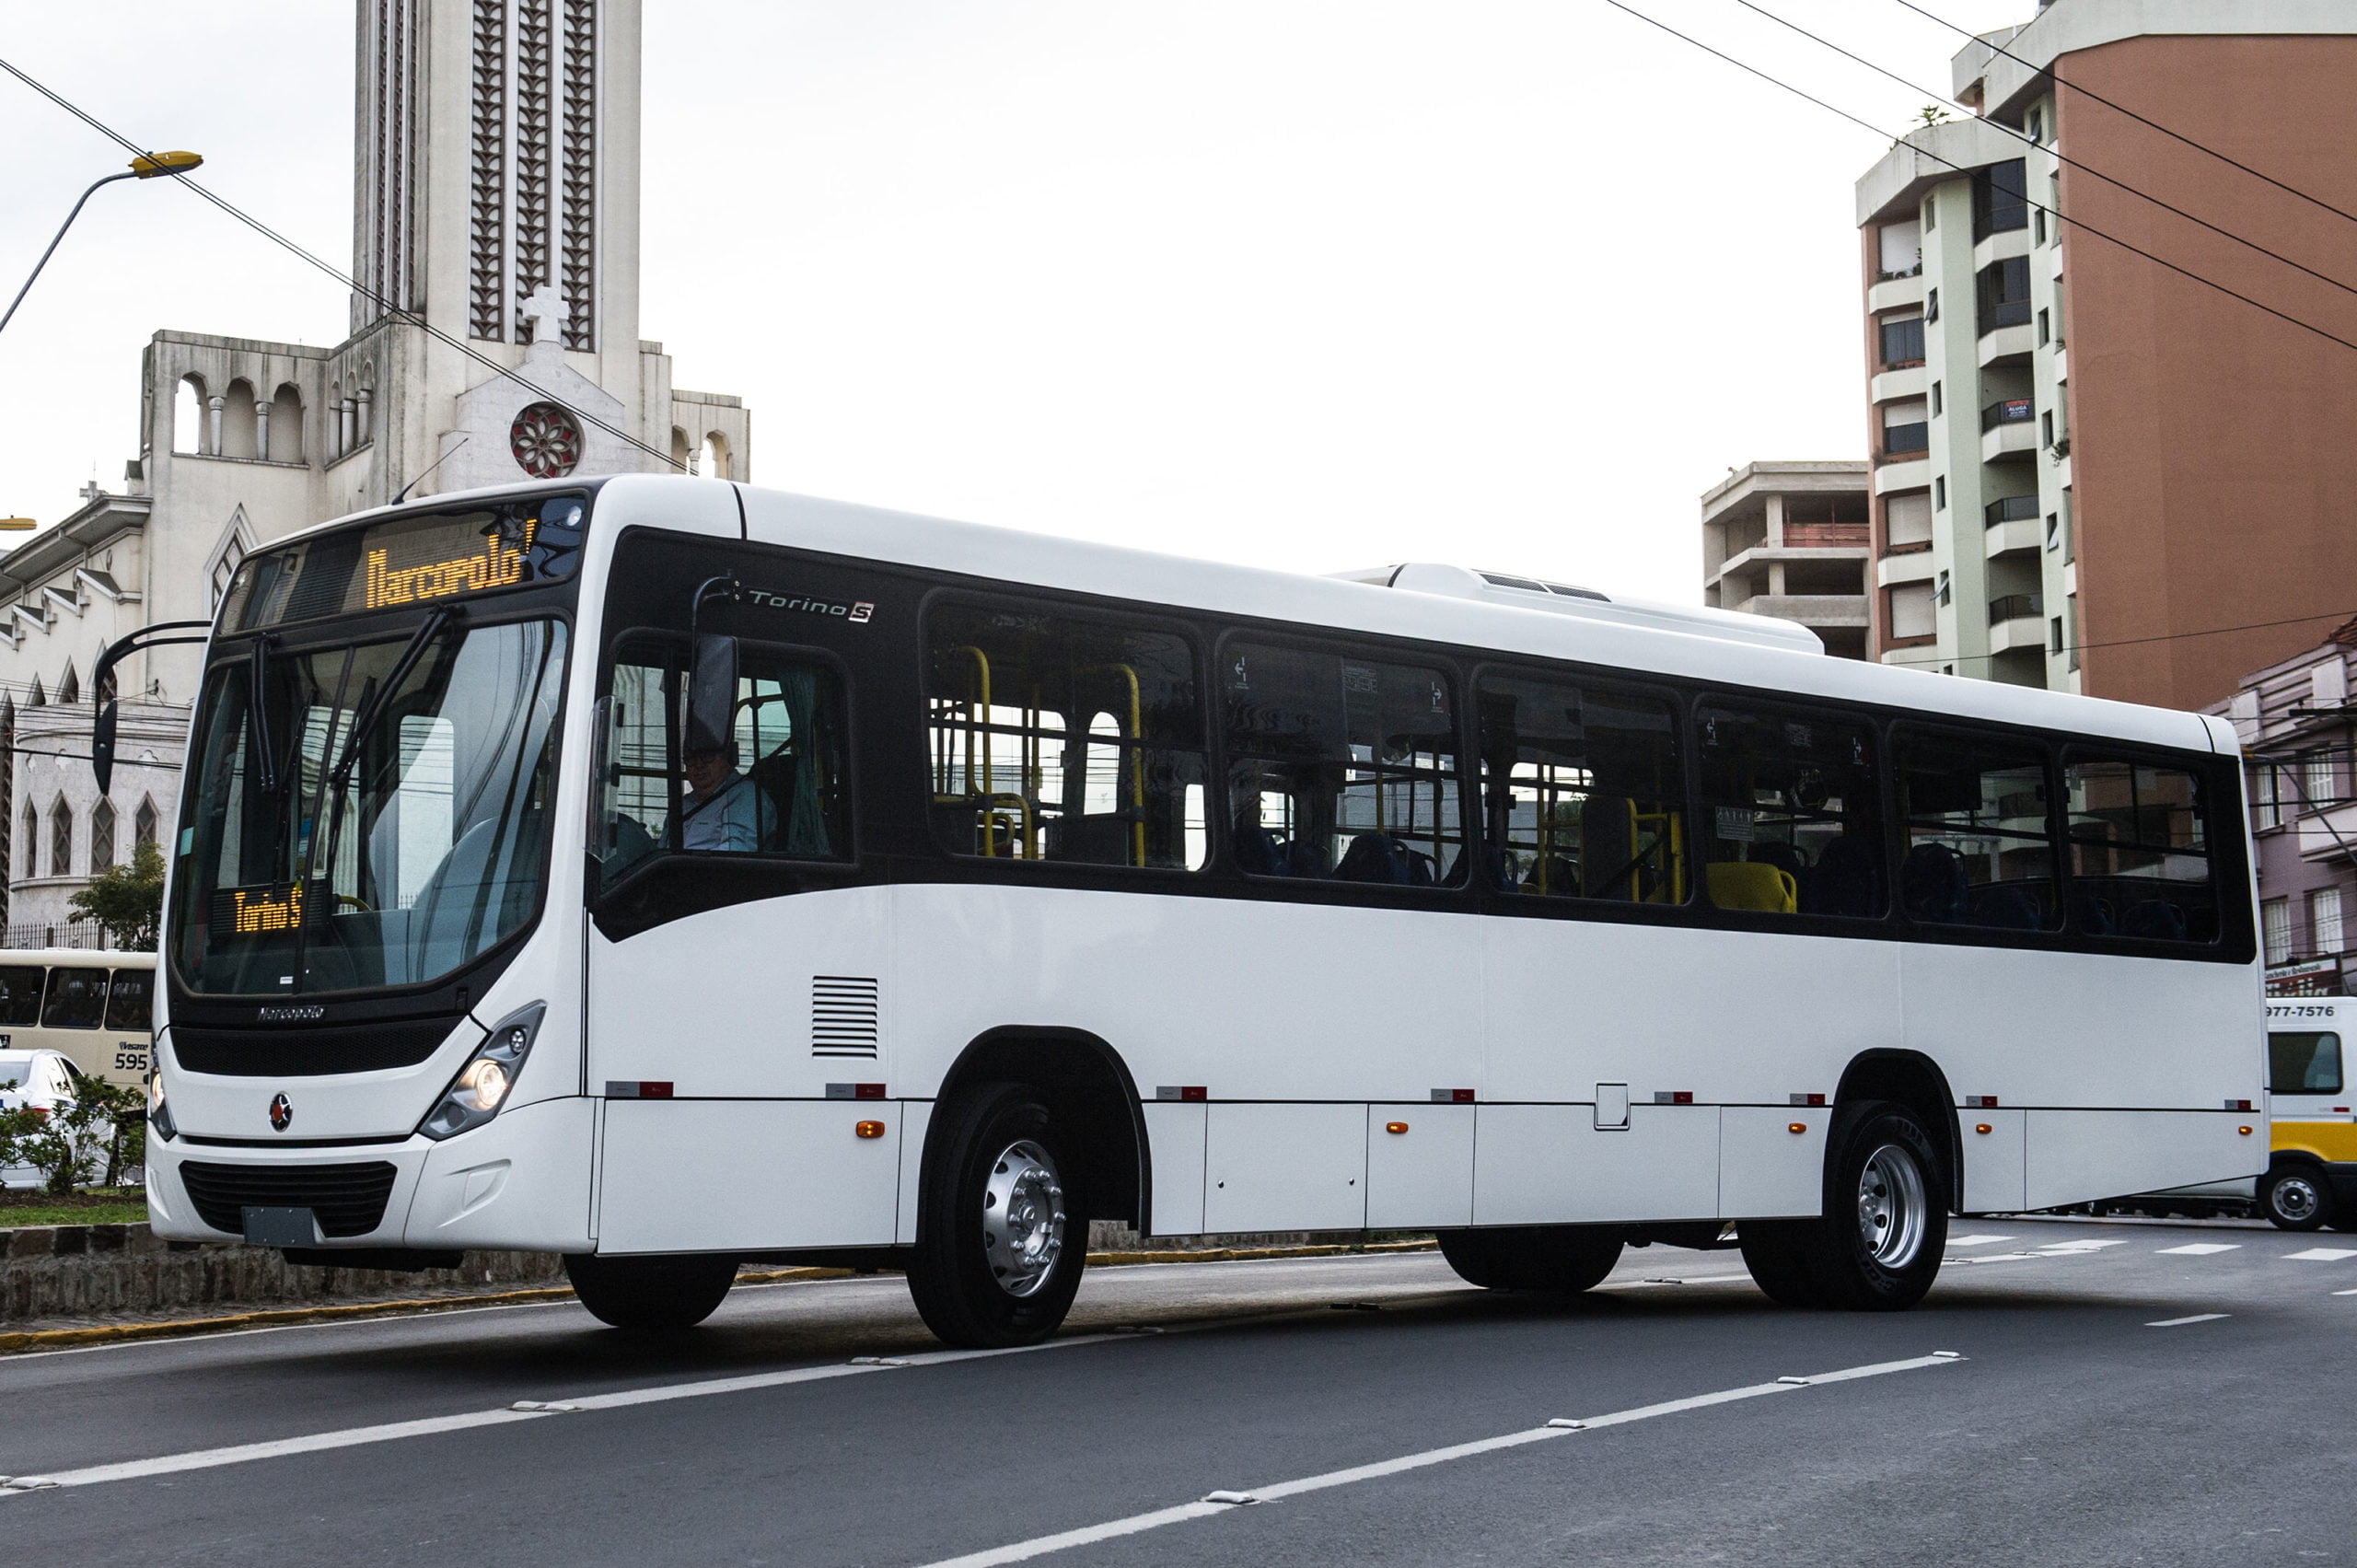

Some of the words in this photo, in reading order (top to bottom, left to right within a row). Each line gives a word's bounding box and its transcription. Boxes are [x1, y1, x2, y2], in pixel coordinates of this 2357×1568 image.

[749, 590, 847, 615] Torino
[234, 891, 287, 933] Torino
[258, 1005, 324, 1021] Marcopolo
[2266, 1006, 2335, 1016] 977-7576
[115, 1053, 148, 1070] 595
